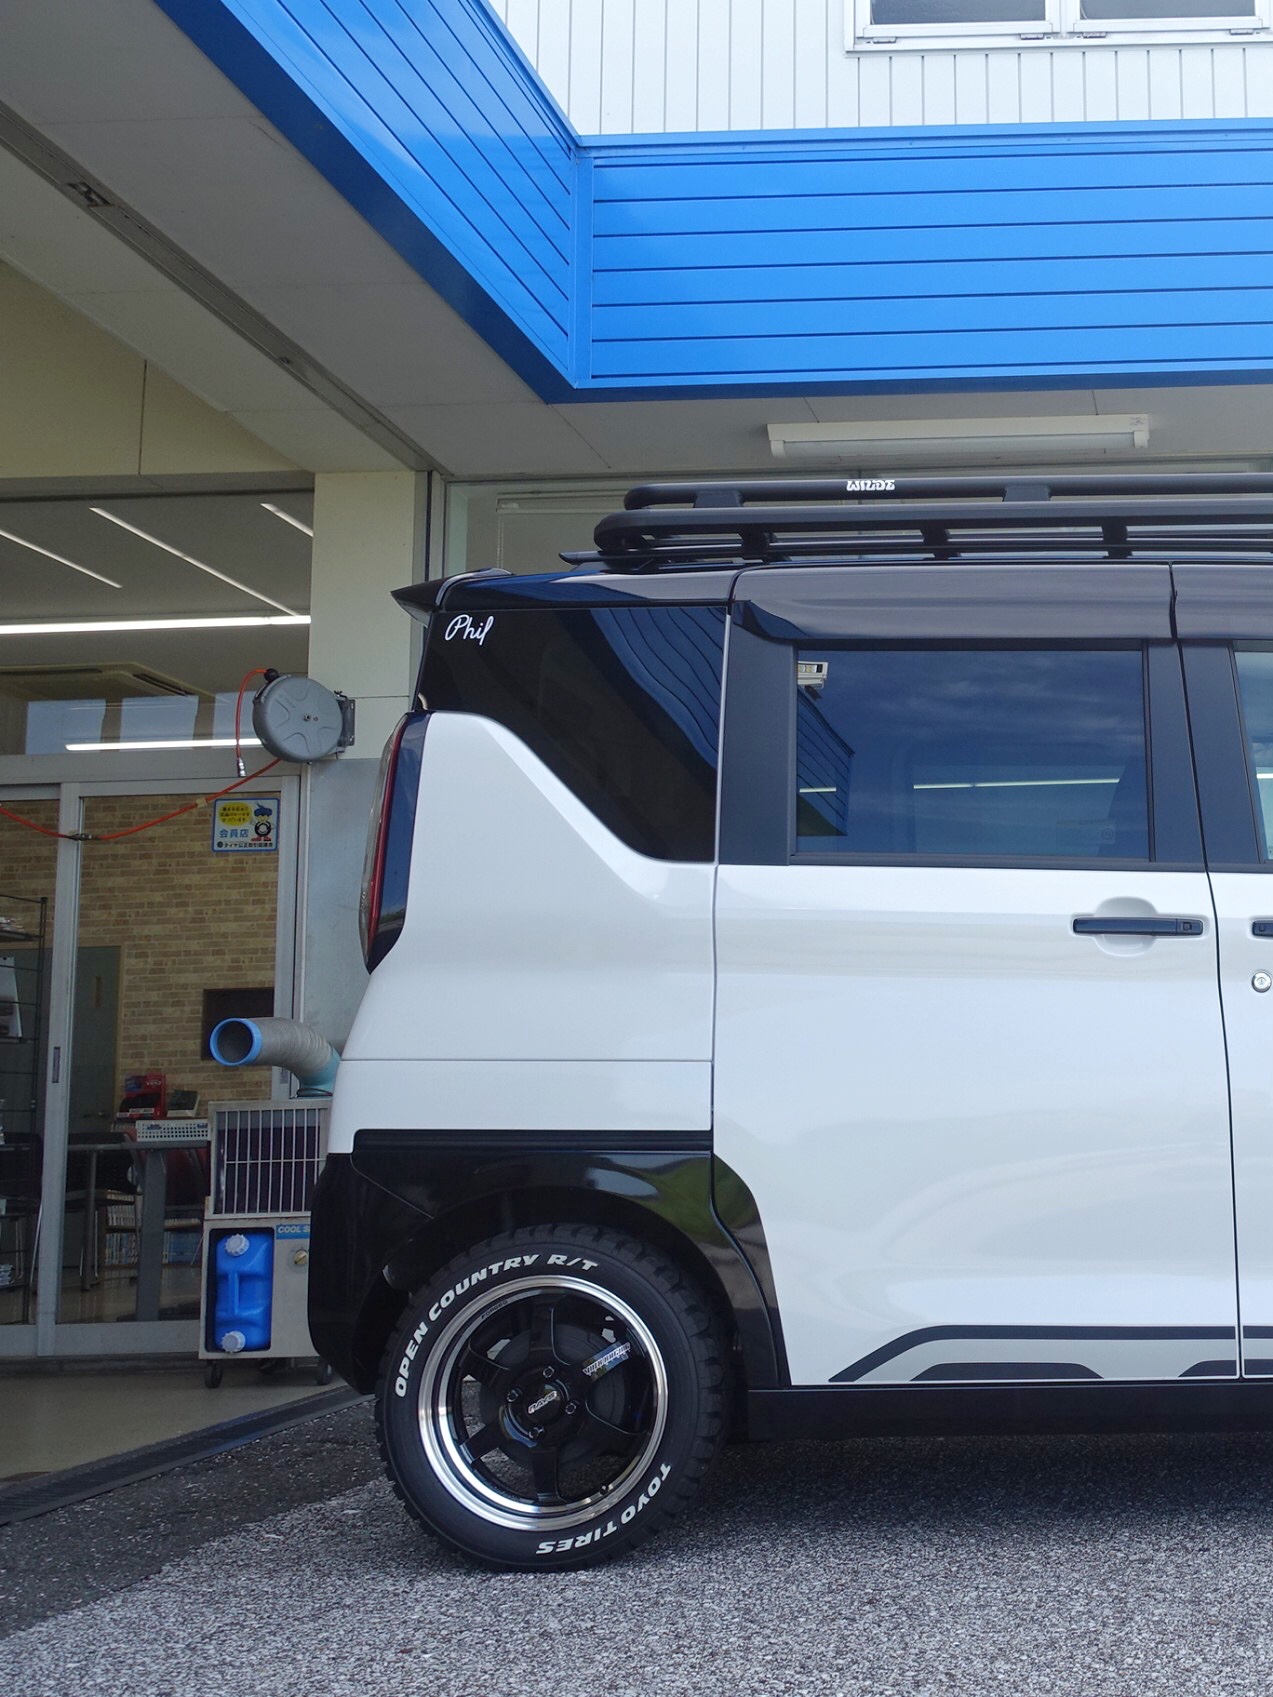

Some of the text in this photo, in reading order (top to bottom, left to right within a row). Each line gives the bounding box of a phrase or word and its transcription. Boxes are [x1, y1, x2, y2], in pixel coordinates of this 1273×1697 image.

[444, 614, 494, 646] Phil
[277, 1225, 302, 1233] COOL
[394, 1253, 599, 1397] OPEN COUNTRY R/T
[535, 1462, 672, 1554] TOYO TIRES
